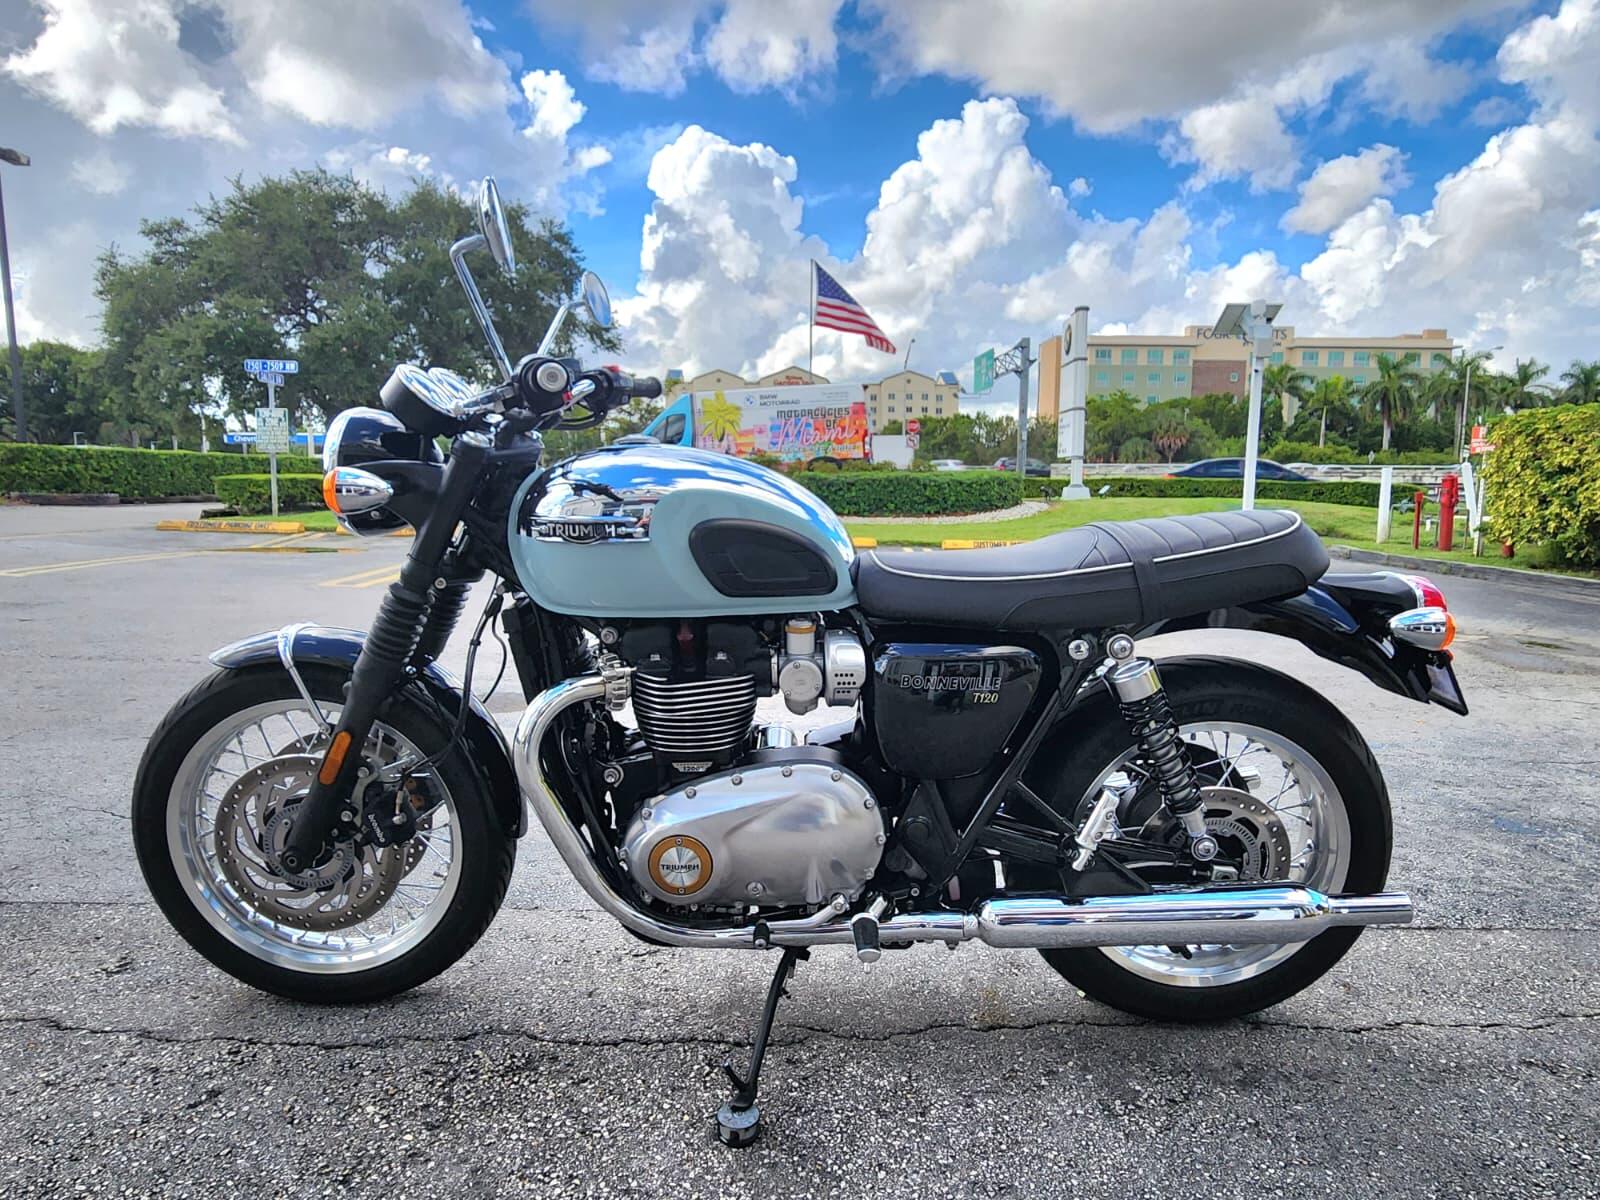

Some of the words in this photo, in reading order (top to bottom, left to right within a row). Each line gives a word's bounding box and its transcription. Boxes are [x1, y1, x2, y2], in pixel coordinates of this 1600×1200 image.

[776, 416, 855, 451] Miami
[548, 523, 616, 537] TRIUMPH
[900, 674, 1001, 691] BONNEVILLE
[973, 692, 999, 703] T120
[367, 812, 386, 843] brembo
[660, 863, 700, 871] TRIUMPH
